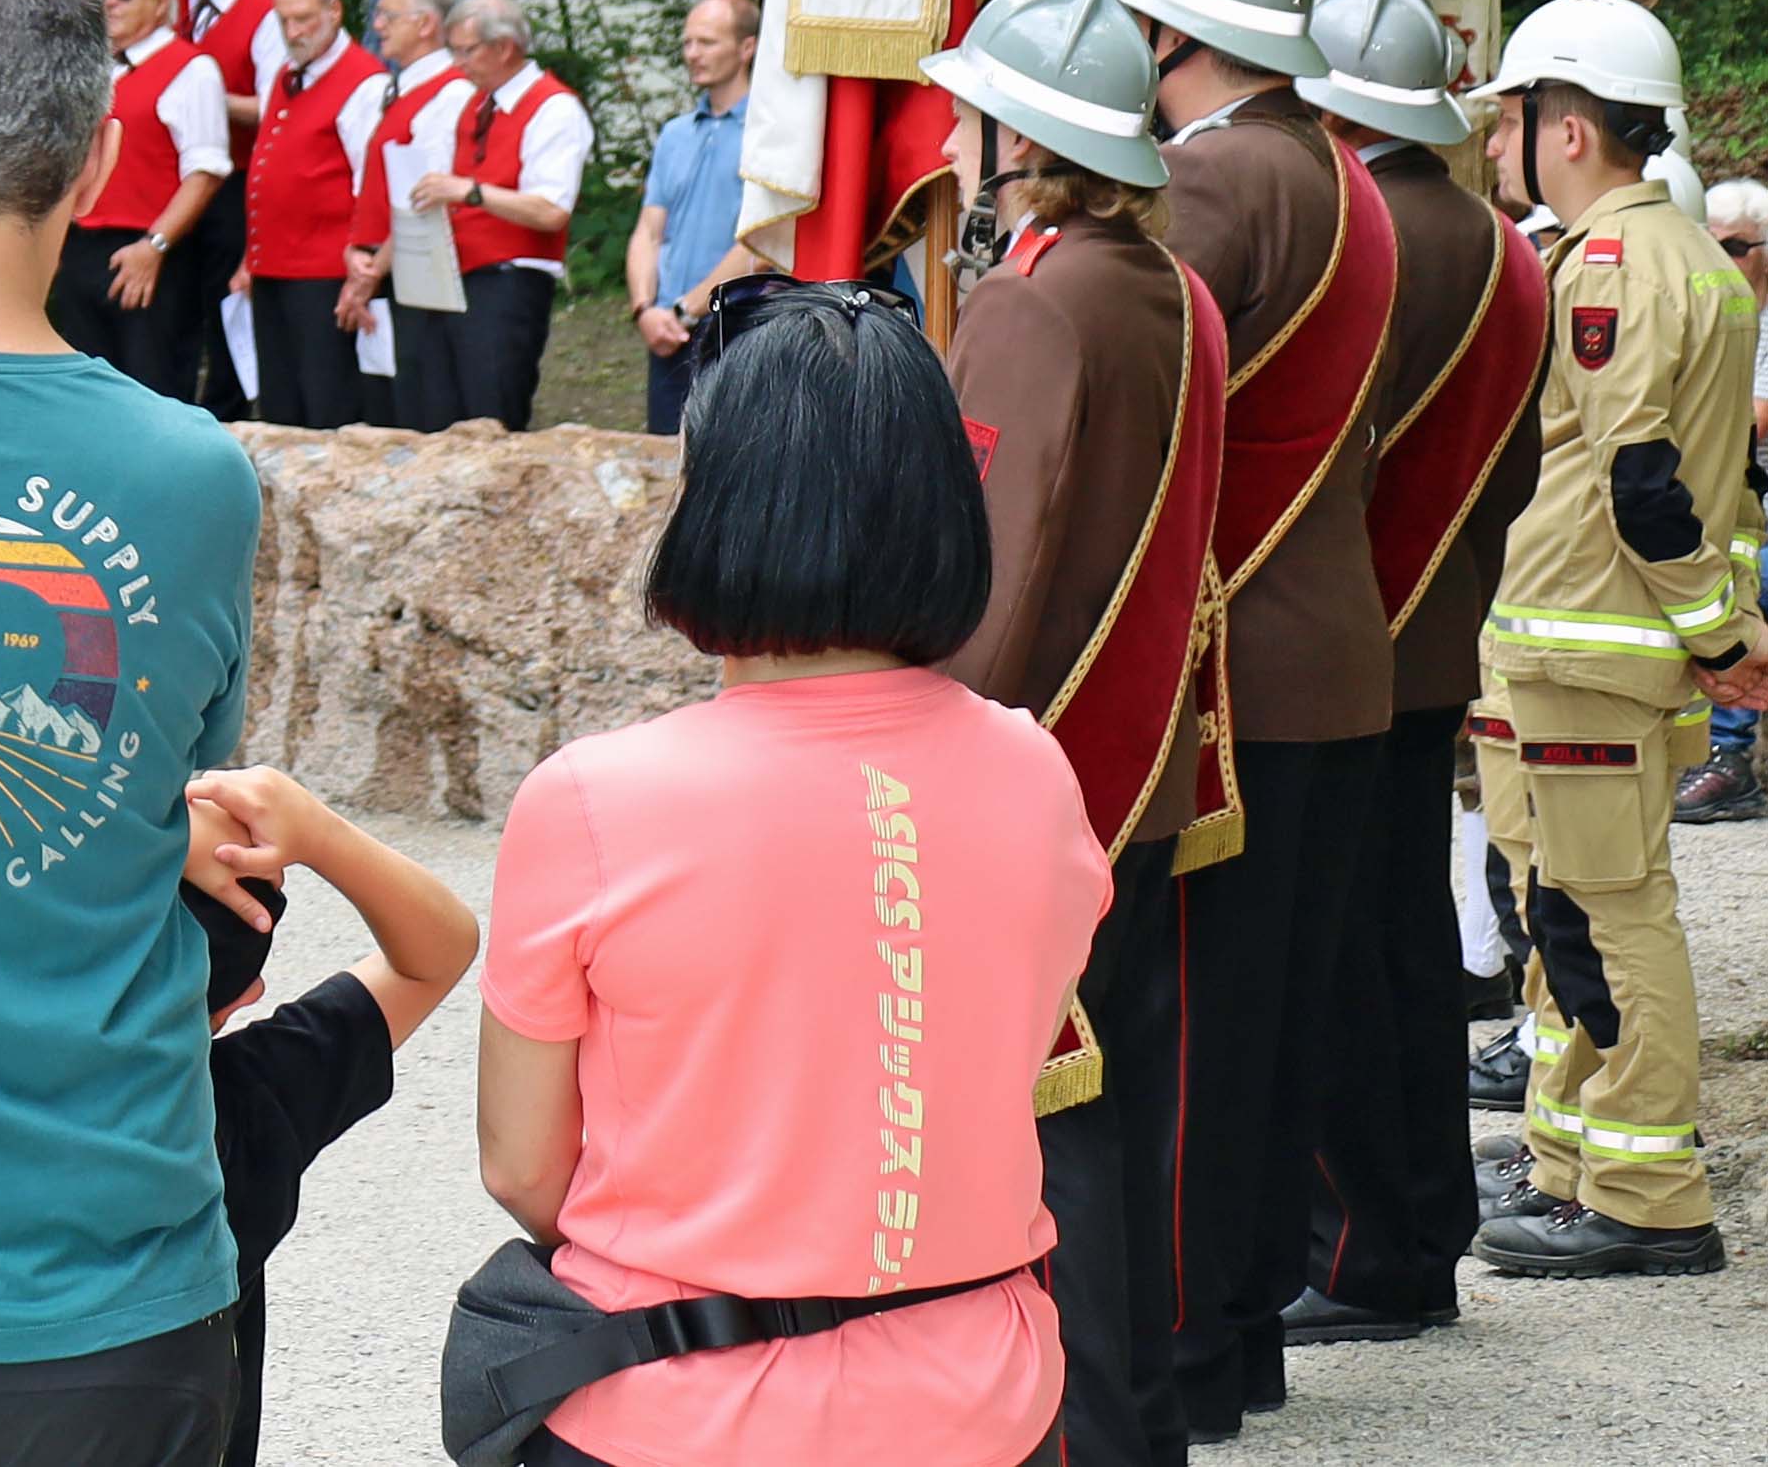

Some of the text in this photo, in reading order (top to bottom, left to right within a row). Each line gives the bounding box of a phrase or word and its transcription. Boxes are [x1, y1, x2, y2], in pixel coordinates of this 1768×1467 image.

[16, 475, 159, 626] SUPPLY
[4, 632, 39, 648] 1969
[6, 731, 140, 888] CALLING
[860, 761, 922, 931] ASICS
